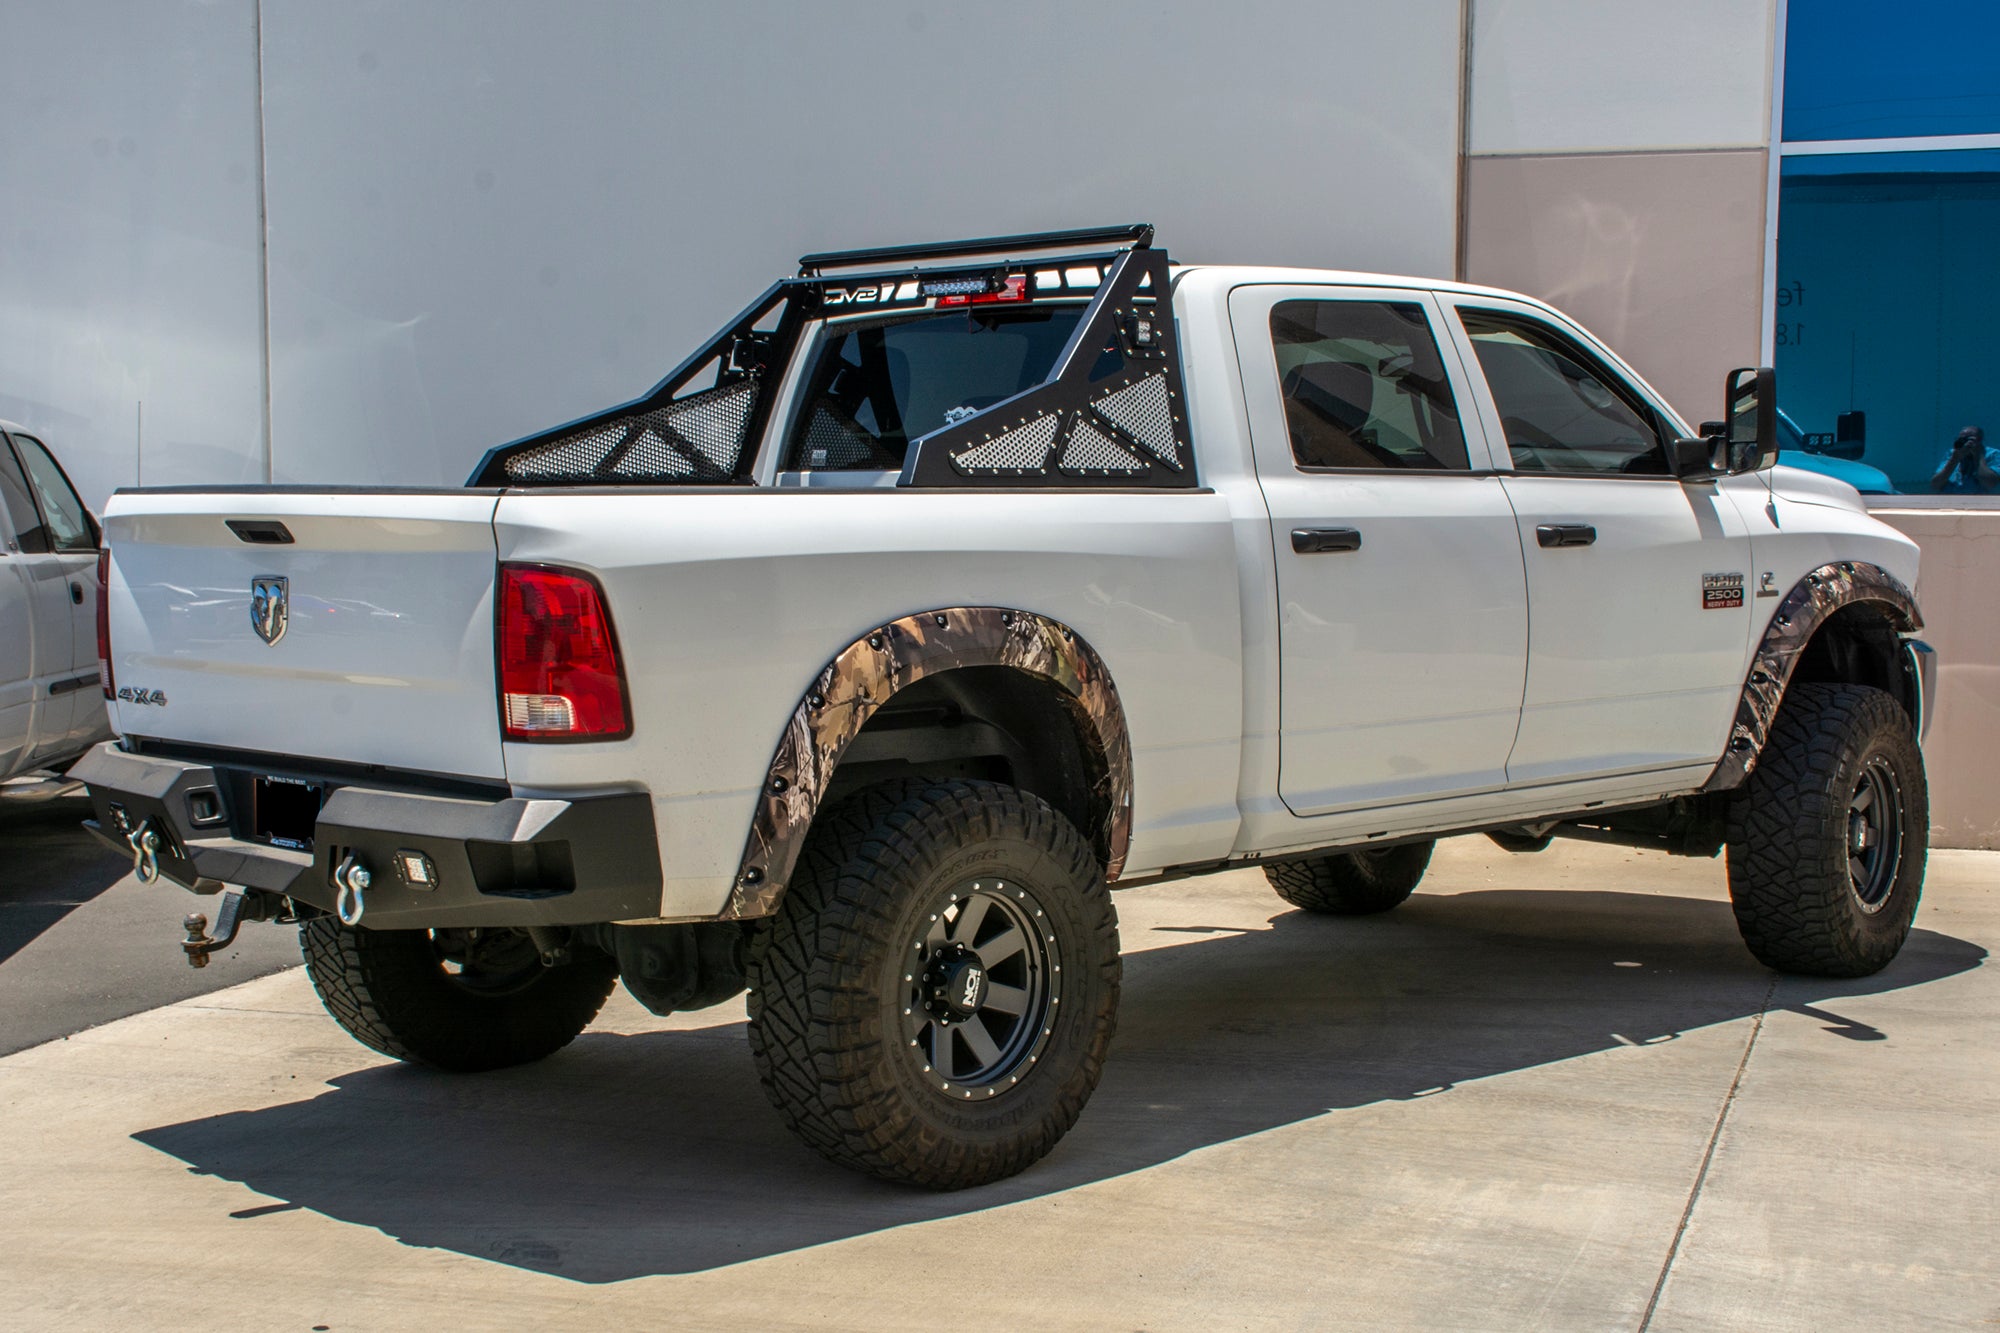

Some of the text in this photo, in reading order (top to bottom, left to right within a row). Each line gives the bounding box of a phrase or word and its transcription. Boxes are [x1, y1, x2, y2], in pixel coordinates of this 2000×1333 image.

[1707, 590, 1740, 600] 2500
[1707, 599, 1740, 608] HEAVY DUTY
